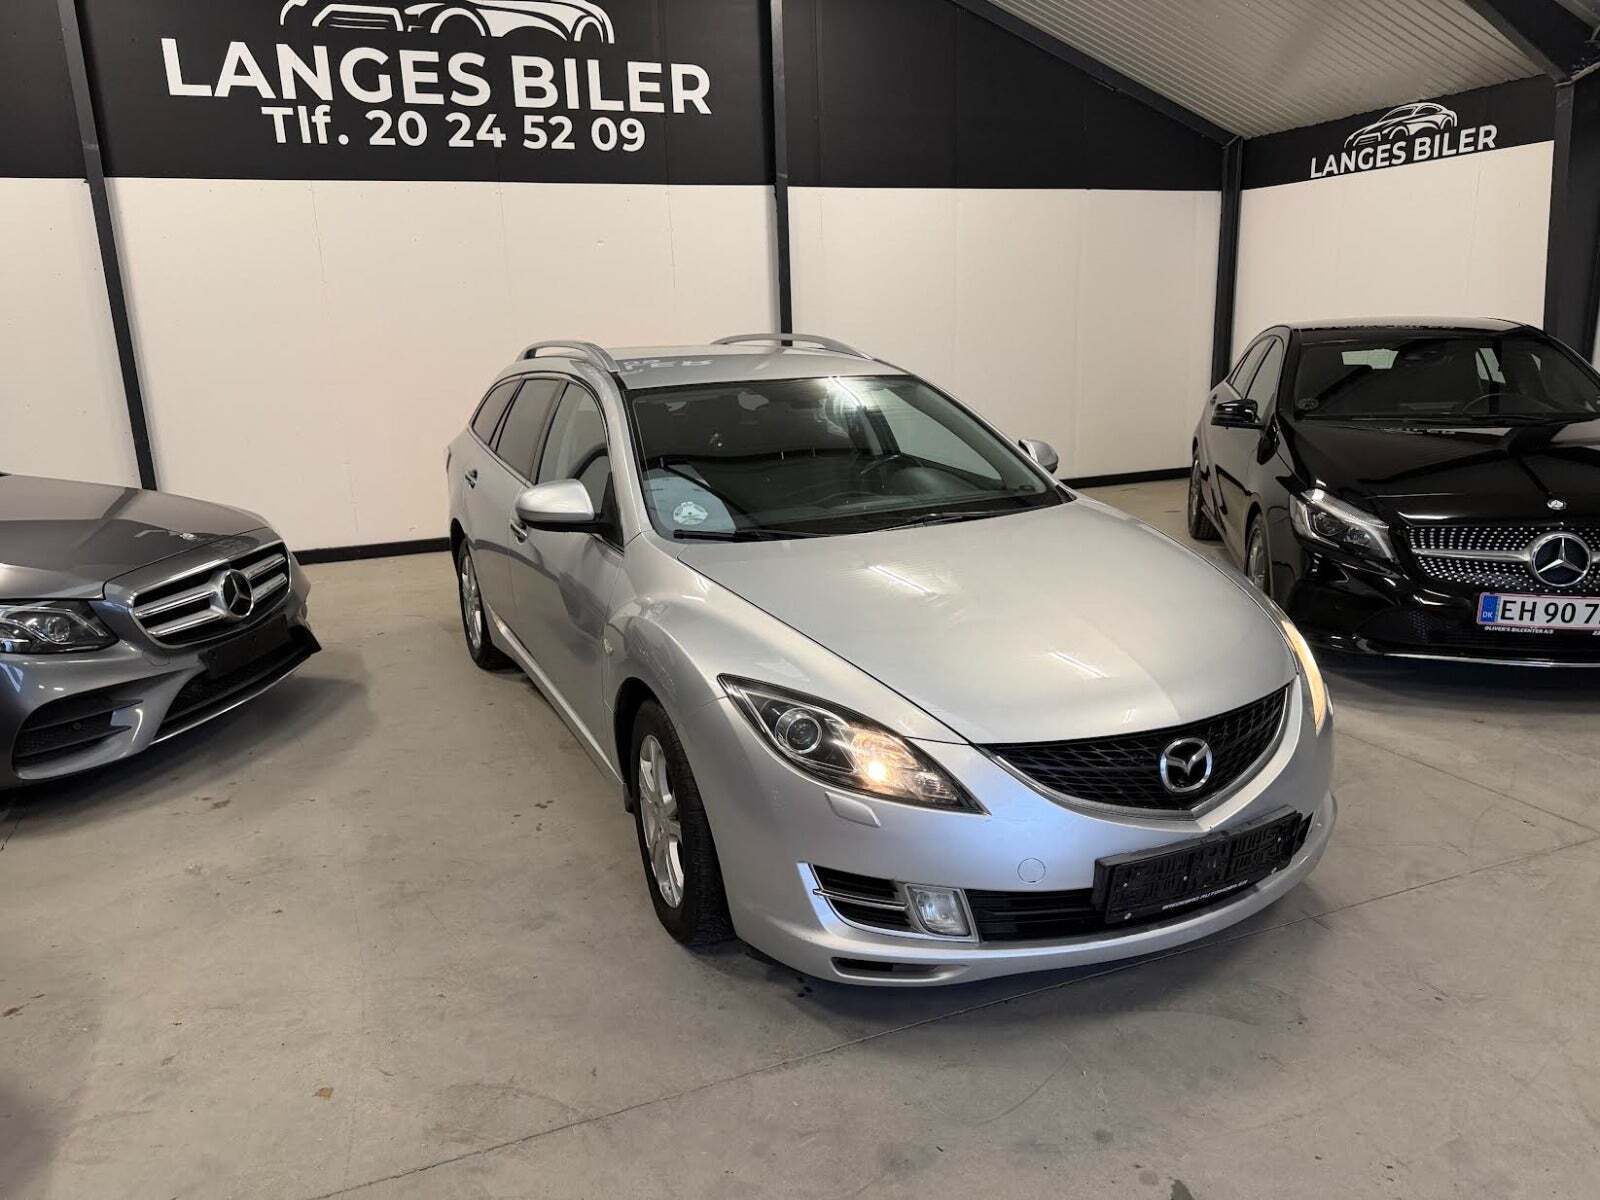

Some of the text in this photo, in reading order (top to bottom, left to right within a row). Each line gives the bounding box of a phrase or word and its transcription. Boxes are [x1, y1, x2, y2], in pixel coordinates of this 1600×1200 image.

[160, 38, 712, 115] LANGES BILER
[261, 105, 646, 152] Tlf. 20 24 52 09
[1310, 124, 1498, 179] LANGES BILER
[1482, 610, 1494, 619] DK
[1500, 600, 1600, 624] EH 90 7
